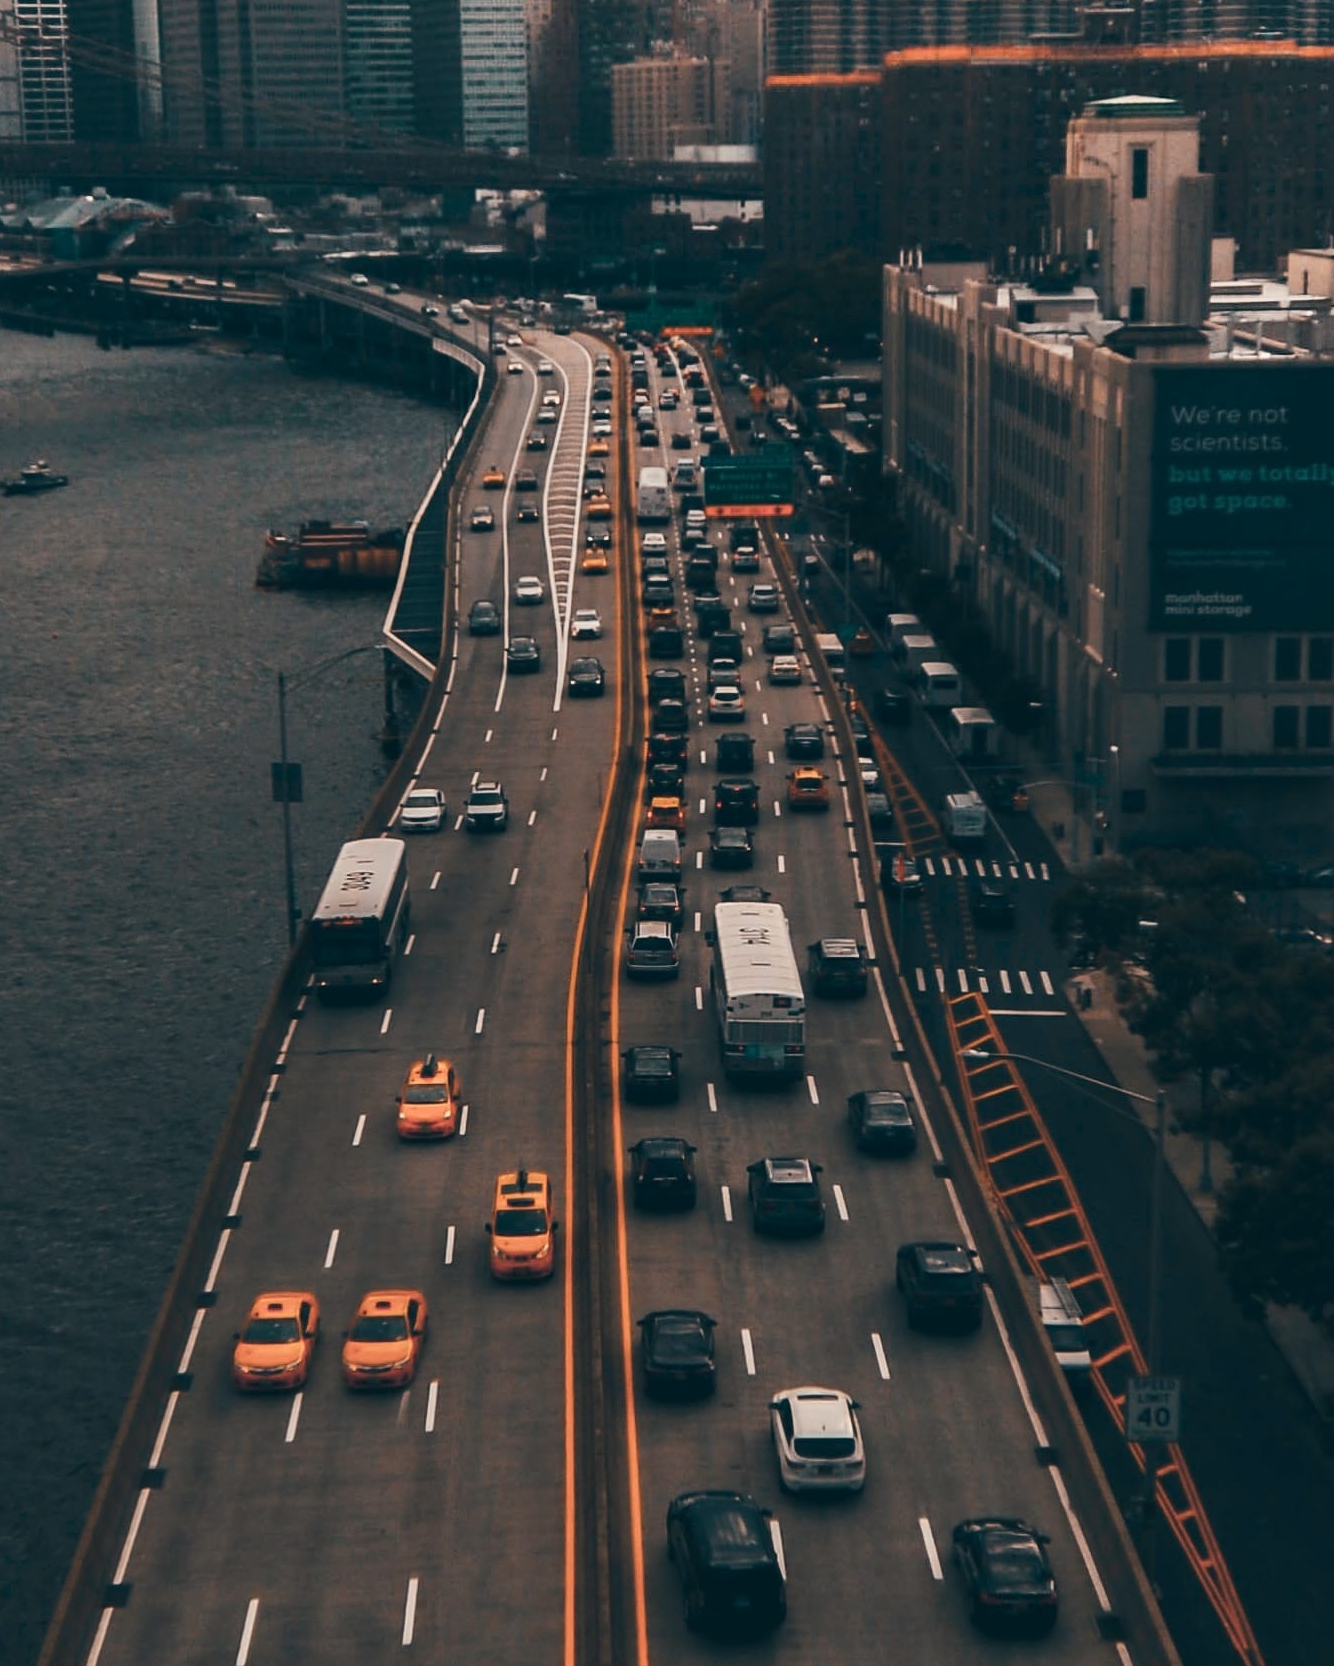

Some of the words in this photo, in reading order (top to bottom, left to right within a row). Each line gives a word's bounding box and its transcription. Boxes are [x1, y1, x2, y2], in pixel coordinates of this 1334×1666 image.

[1170, 405, 1241, 425] We're
[1248, 405, 1290, 425] not
[1168, 466, 1211, 483] but
[1218, 470, 1252, 482] we
[1168, 495, 1209, 516] got
[1165, 590, 1243, 603] manhattan
[1165, 604, 1194, 615] mini
[1197, 603, 1252, 618] storage
[1138, 1406, 1170, 1427] 40
